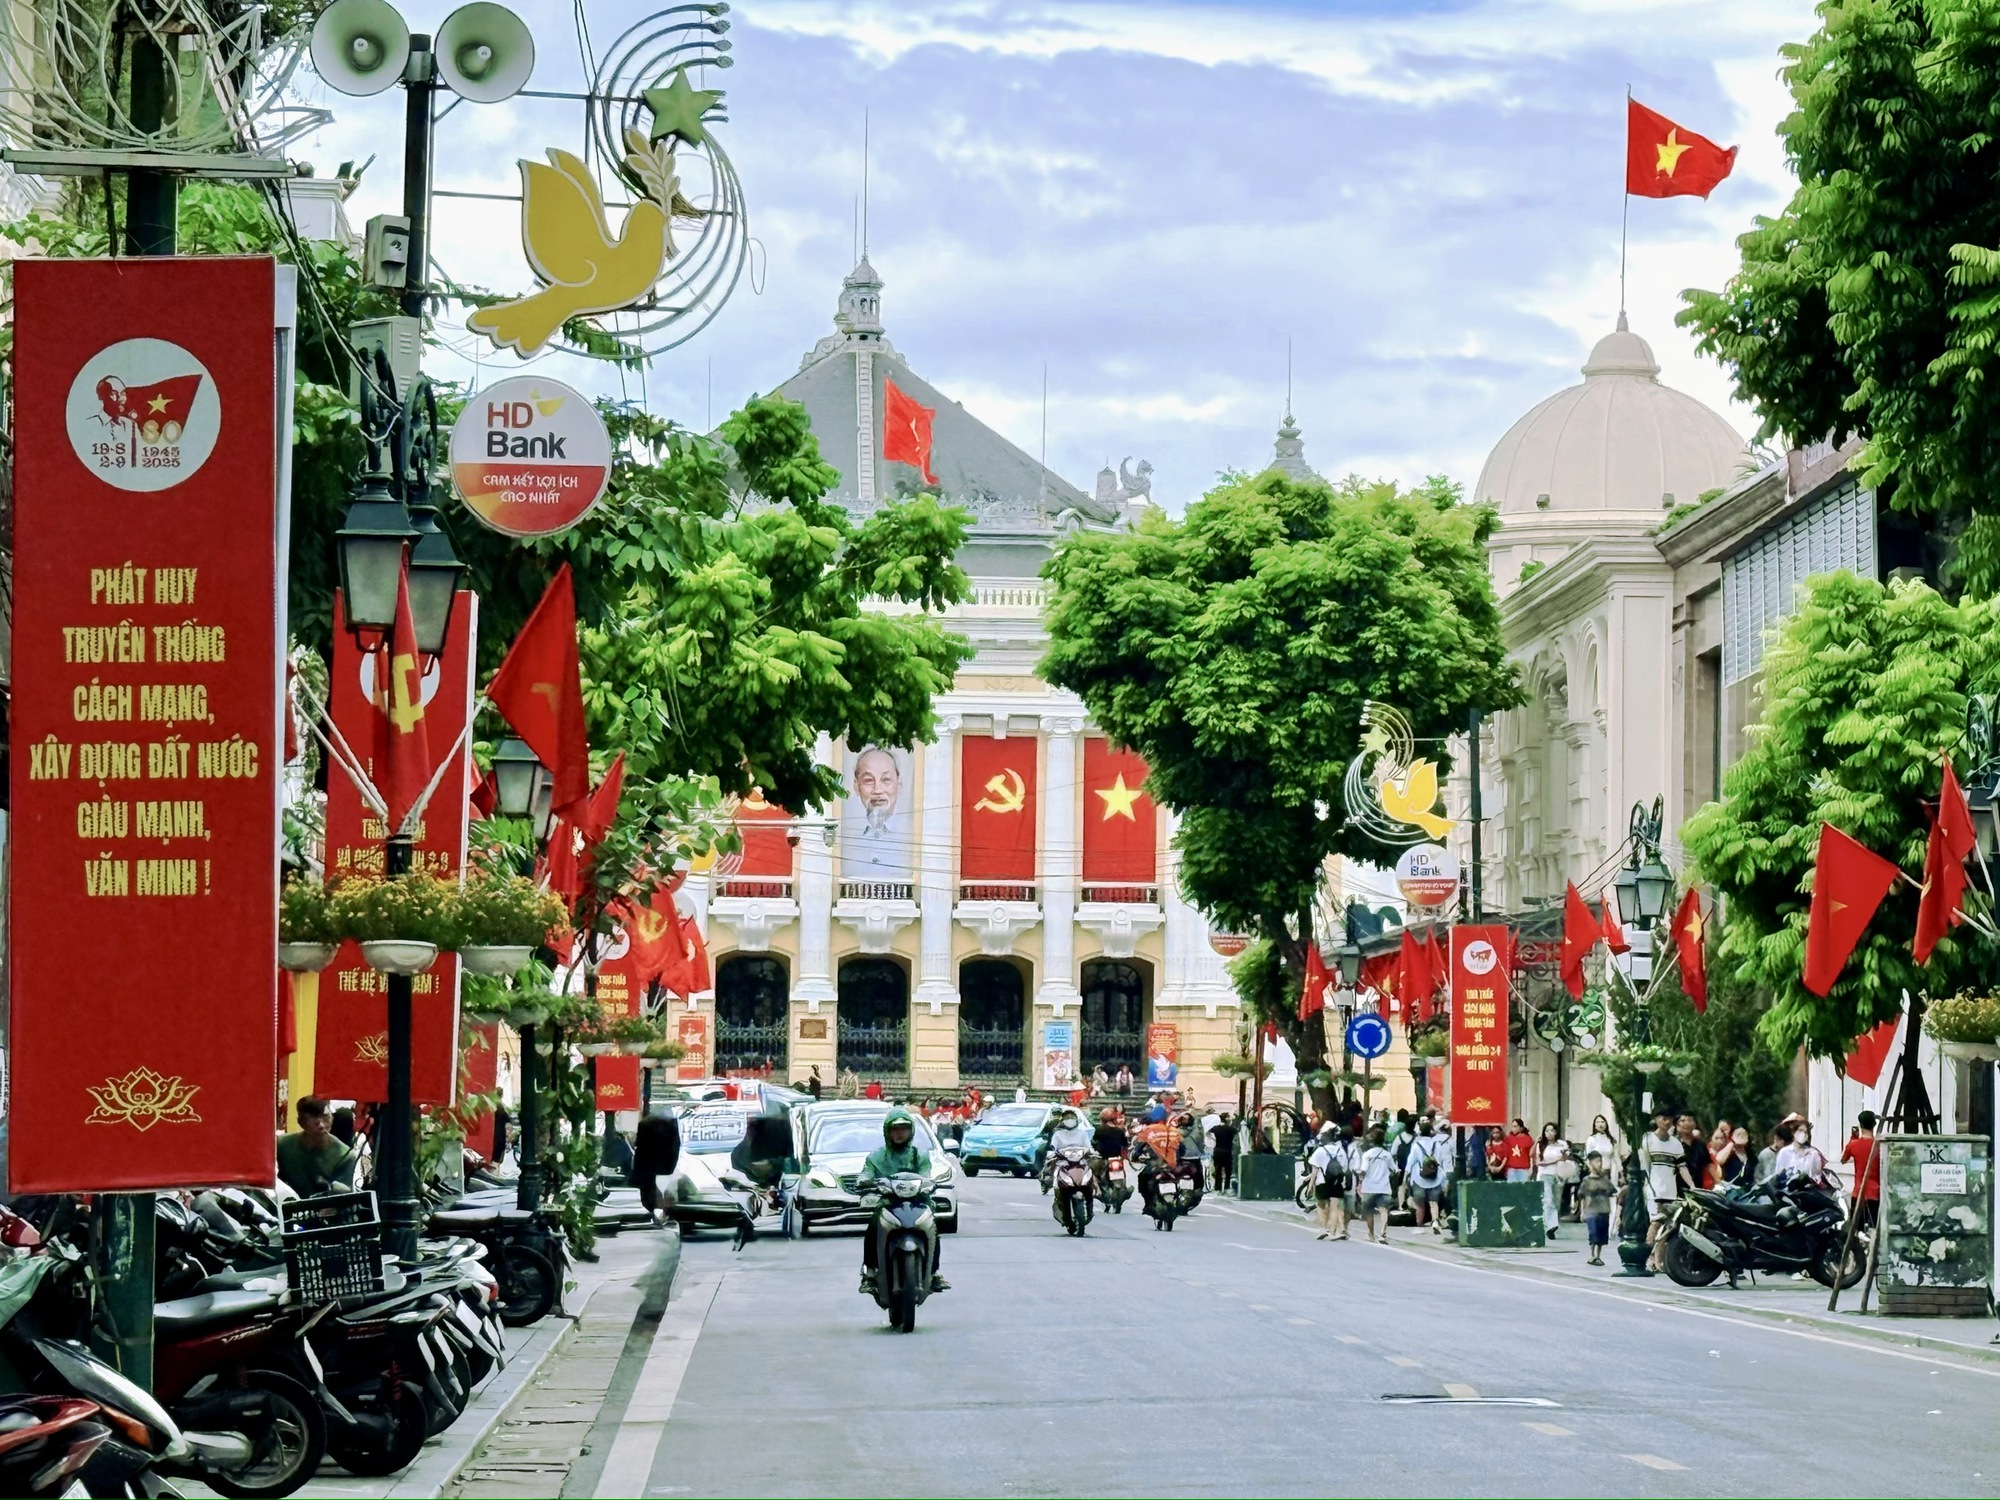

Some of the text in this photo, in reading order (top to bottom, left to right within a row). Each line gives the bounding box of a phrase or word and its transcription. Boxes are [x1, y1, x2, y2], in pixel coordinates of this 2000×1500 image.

[487, 401, 533, 429] HD
[142, 446, 180, 458] 1945
[142, 457, 180, 468] 2025
[487, 430, 567, 459] Bank
[483, 474, 510, 486] CAM
[559, 473, 578, 488] ÍCH
[500, 488, 560, 503] CAO NHẤT
[91, 560, 197, 604] PHÁT HUY
[62, 618, 225, 663] TRUYỀN THỐNG
[73, 677, 215, 728] CÁCH MẠNG,
[30, 733, 258, 787] XÂY DỰNG ĐẤT NƯỚC
[77, 794, 211, 845] GIÀU MẠNH,
[85, 851, 128, 896] VĂN
[137, 860, 197, 896] MINH
